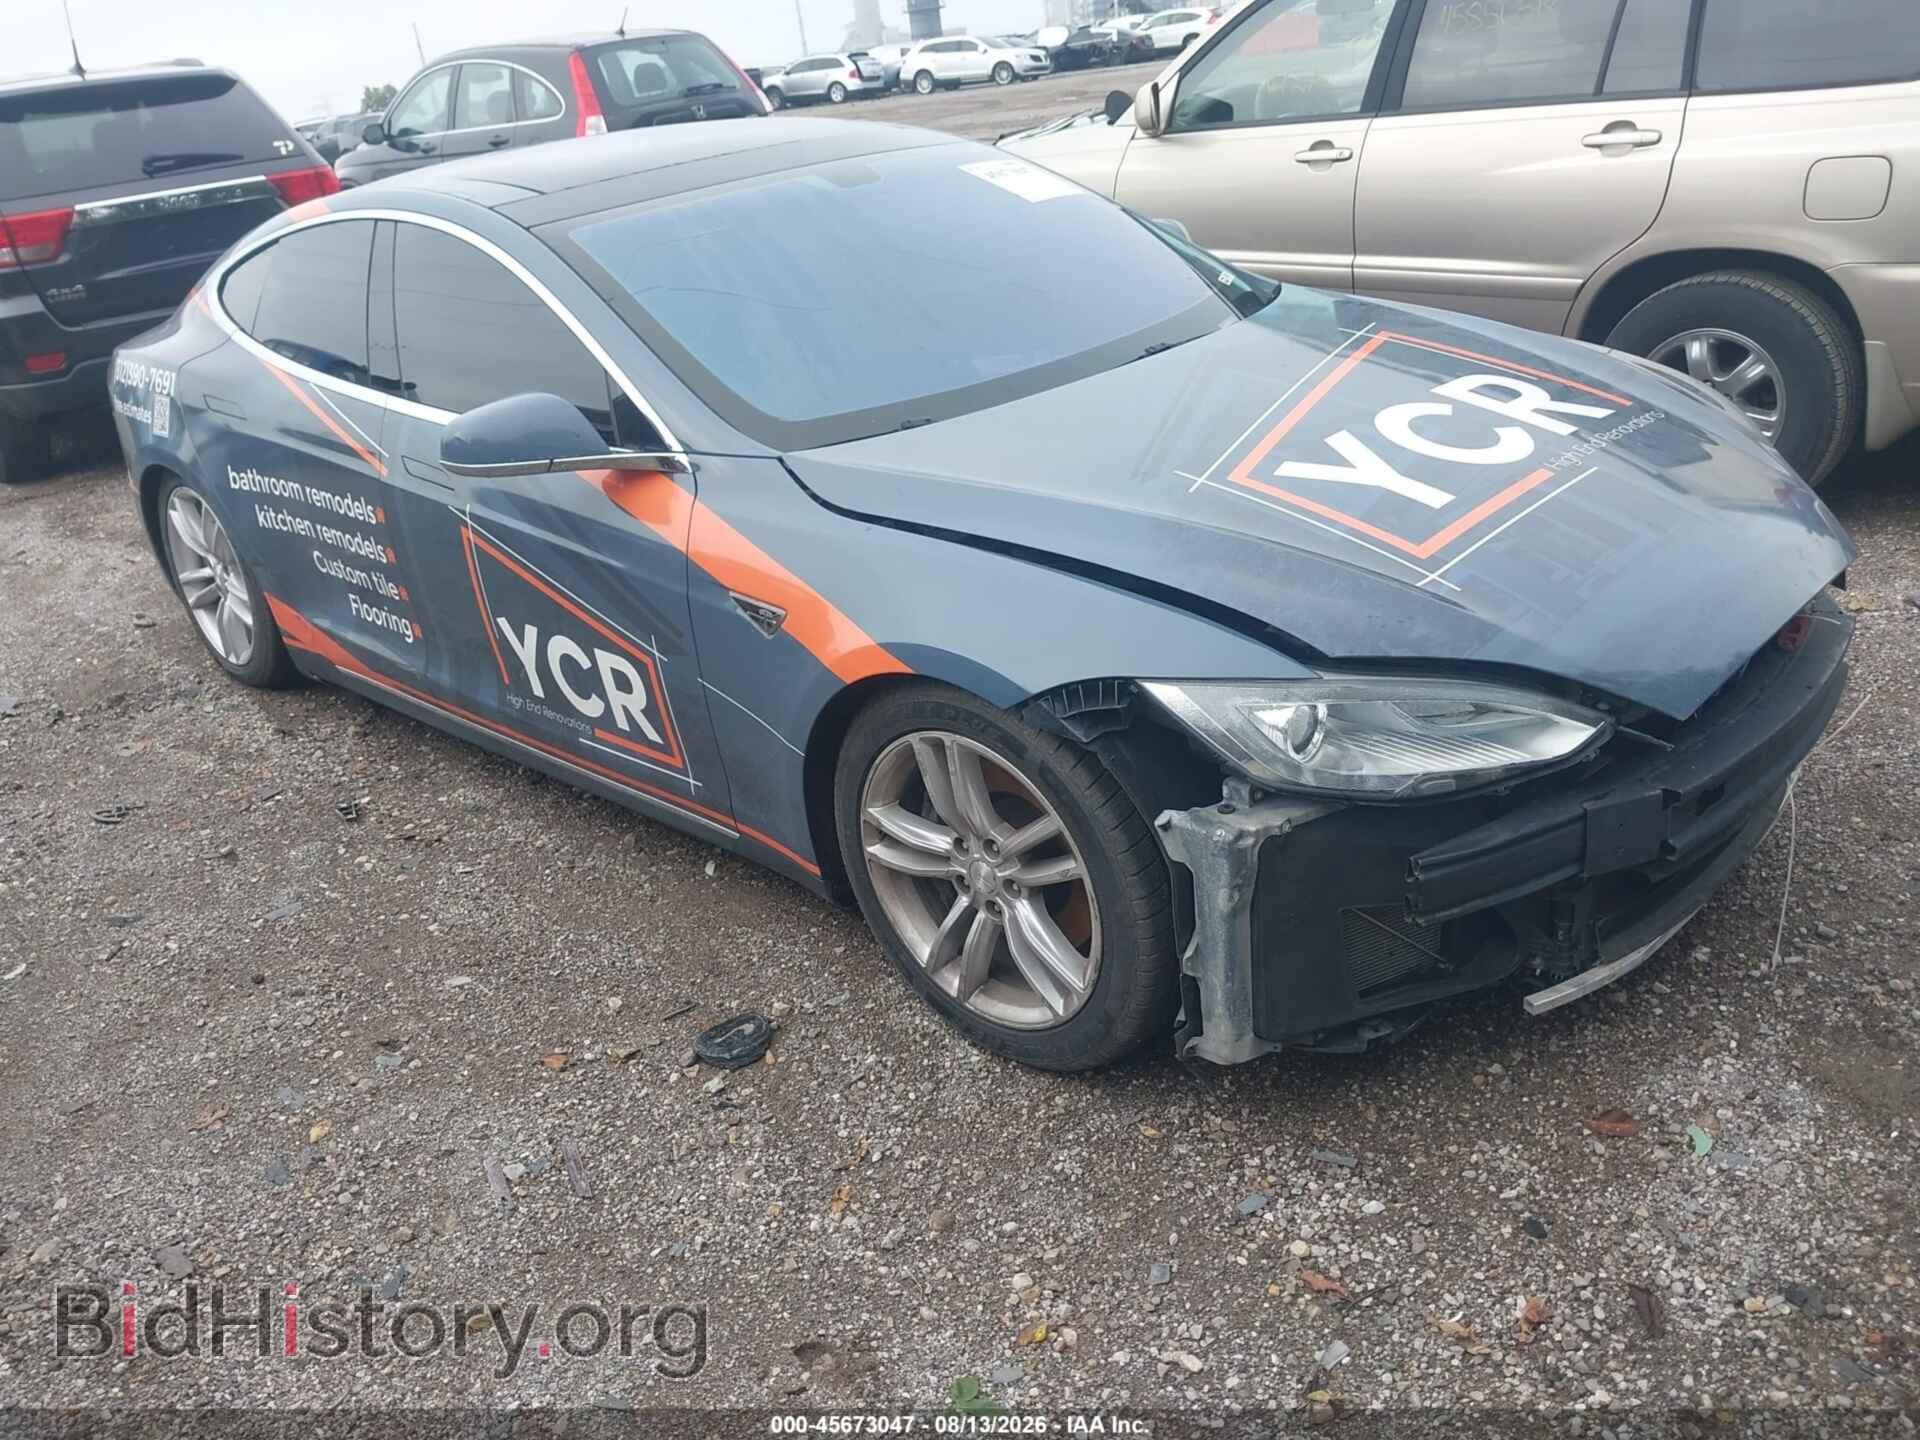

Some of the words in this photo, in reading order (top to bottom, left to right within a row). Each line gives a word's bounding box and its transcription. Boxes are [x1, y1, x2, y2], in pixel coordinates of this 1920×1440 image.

[1272, 374, 1616, 510] YCR
[227, 464, 302, 502] bathroom
[305, 485, 377, 525] remodels
[255, 503, 315, 539] kitchen
[316, 523, 388, 564] remodels
[313, 550, 372, 589] Custom
[372, 568, 400, 601] tile
[348, 593, 414, 644] Flooring
[496, 616, 664, 745] YCR
[506, 690, 526, 710] High
[526, 697, 542, 715] End
